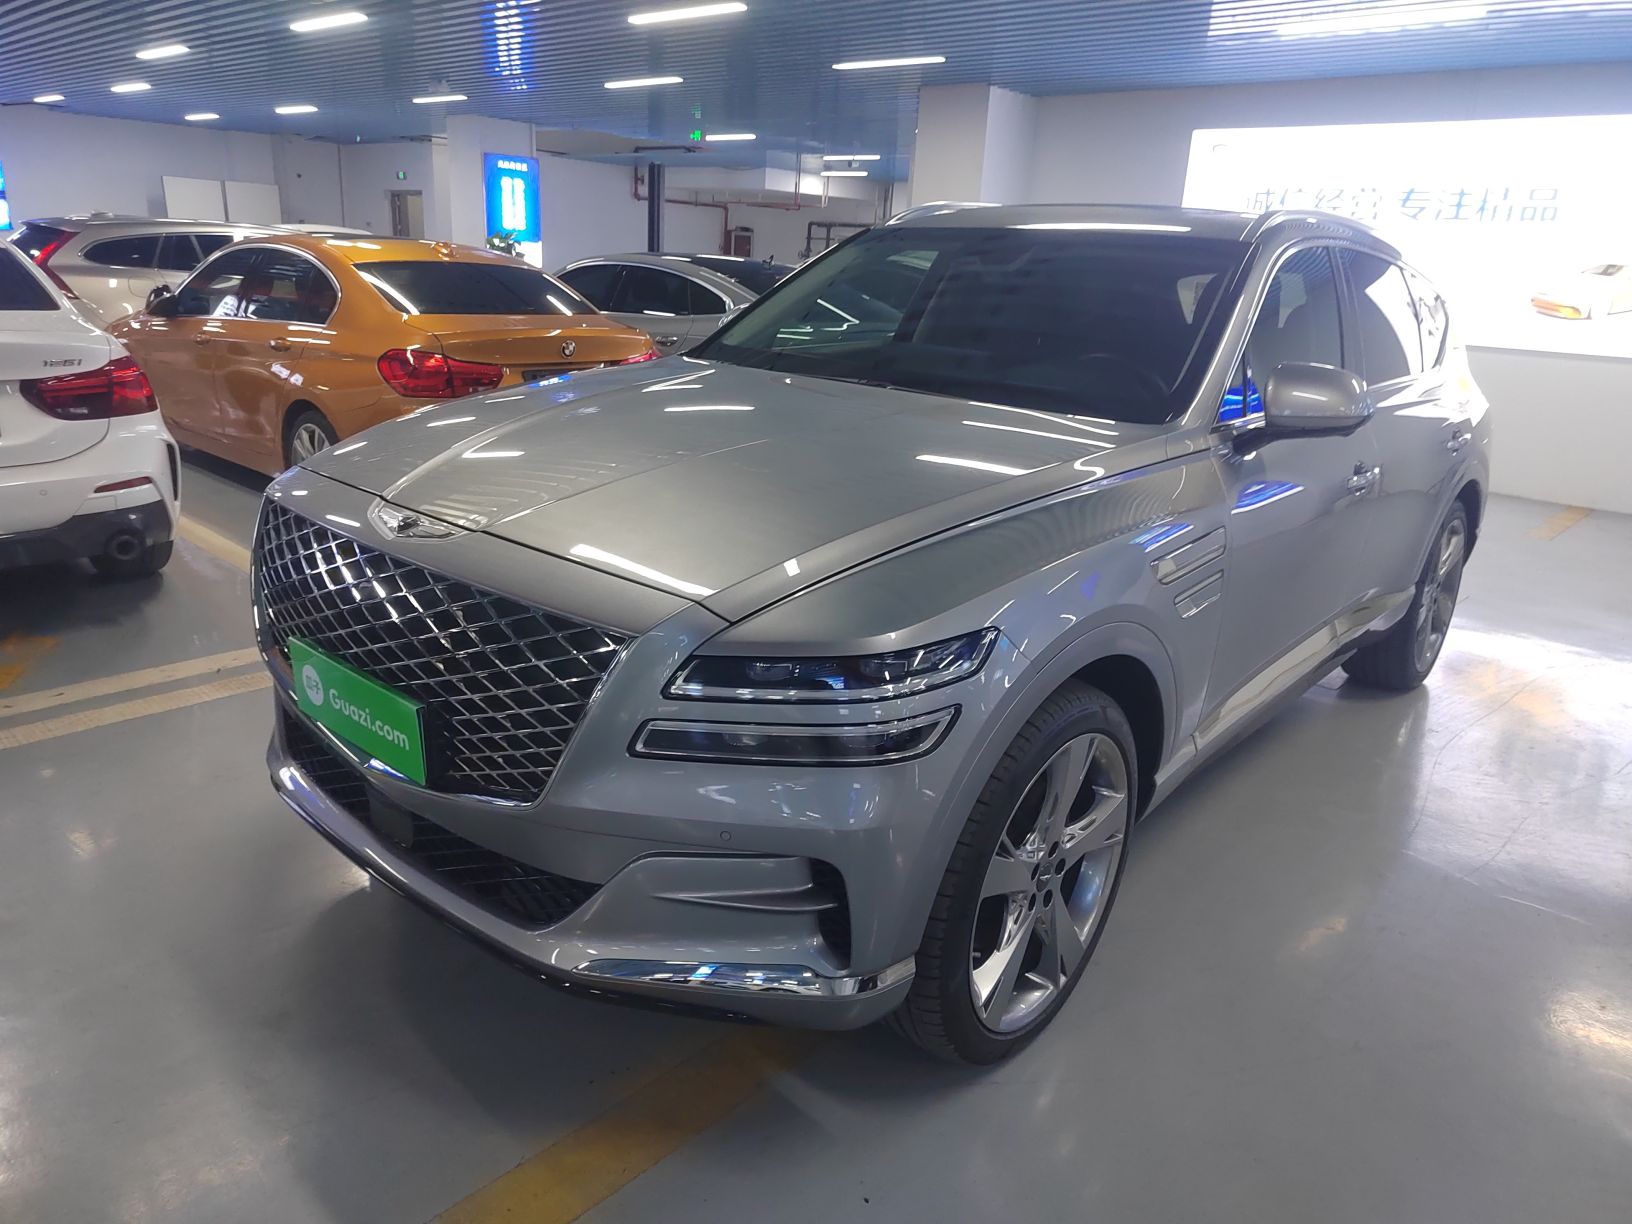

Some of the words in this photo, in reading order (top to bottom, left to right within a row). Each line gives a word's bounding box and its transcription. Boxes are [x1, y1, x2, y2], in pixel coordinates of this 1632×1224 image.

[1397, 188, 1558, 222] 专注精品
[328, 688, 410, 751] Guazi.com
